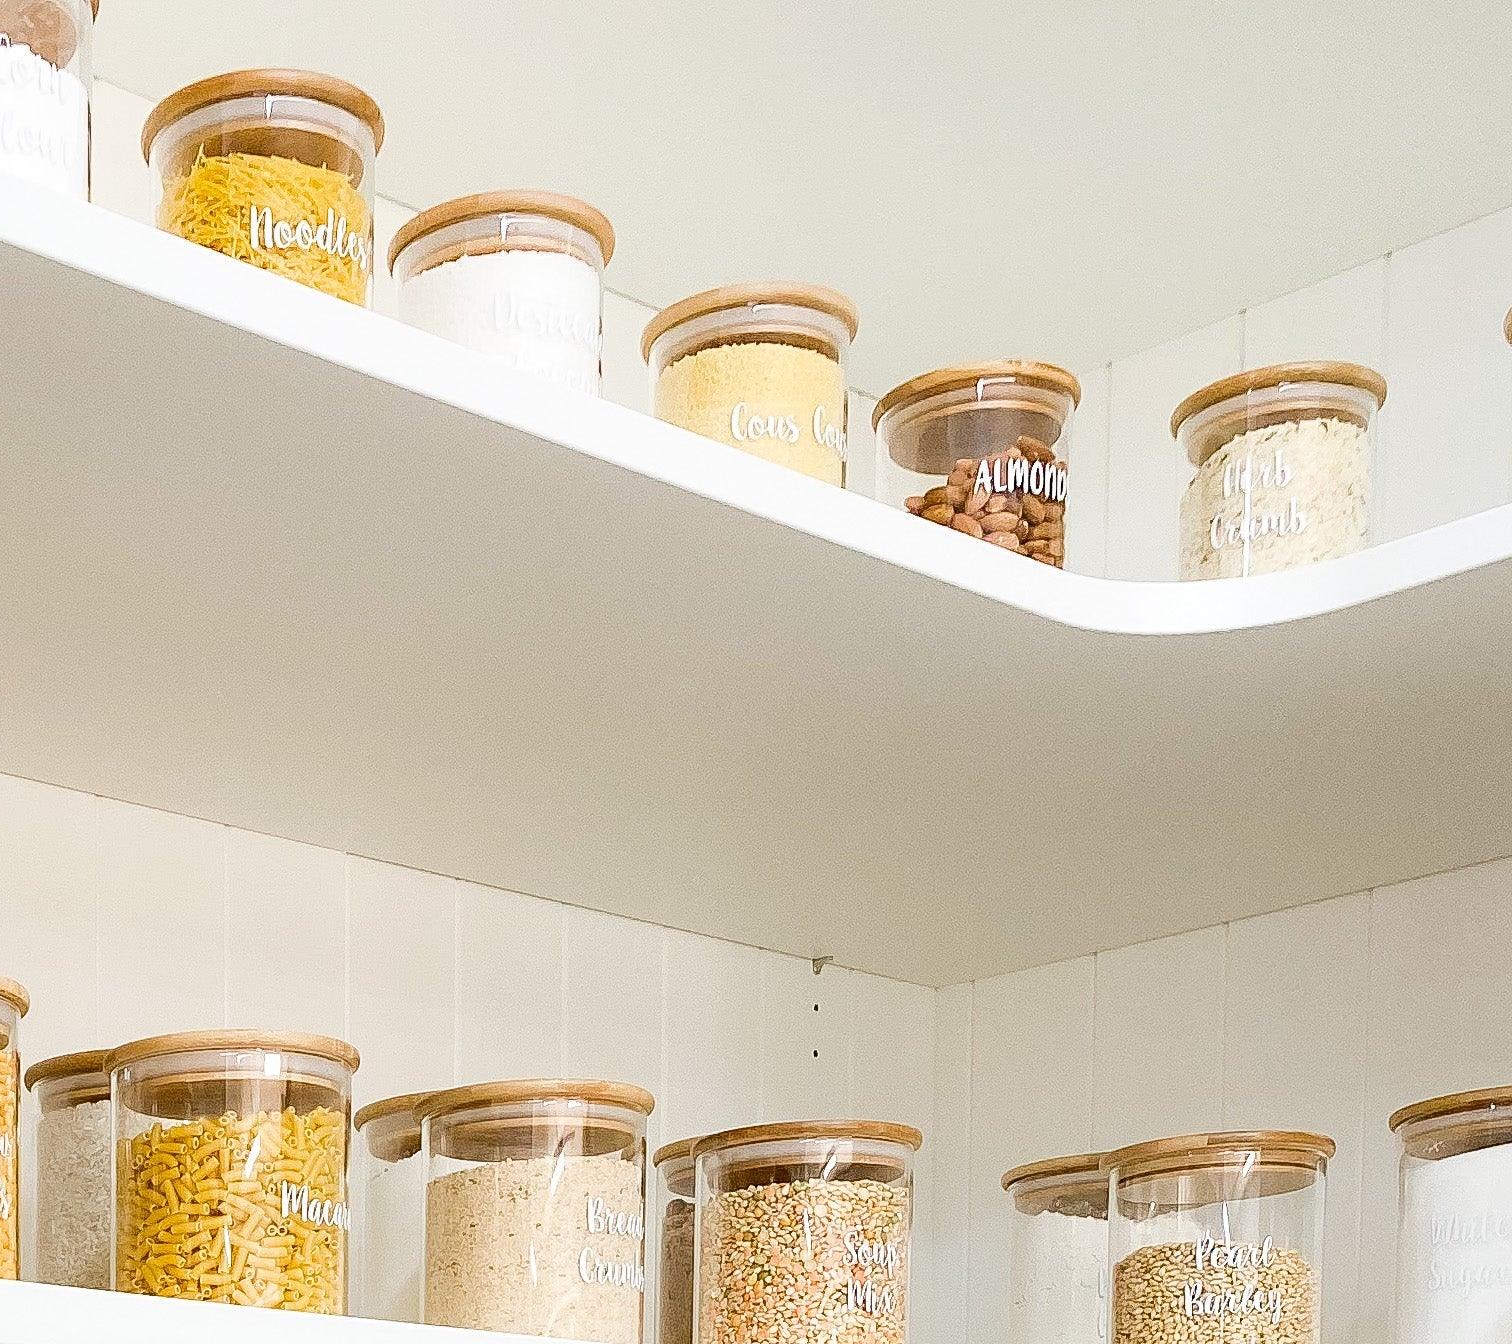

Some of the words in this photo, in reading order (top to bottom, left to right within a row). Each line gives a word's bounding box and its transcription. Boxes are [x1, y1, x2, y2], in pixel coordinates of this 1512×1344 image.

[730, 400, 802, 443] Cous
[974, 458, 1070, 502] ALMOND
[843, 1229, 902, 1279] Soup
[1193, 1231, 1274, 1271] Pearl
[846, 1273, 899, 1317] Mix
[1184, 1276, 1285, 1323] Barley
